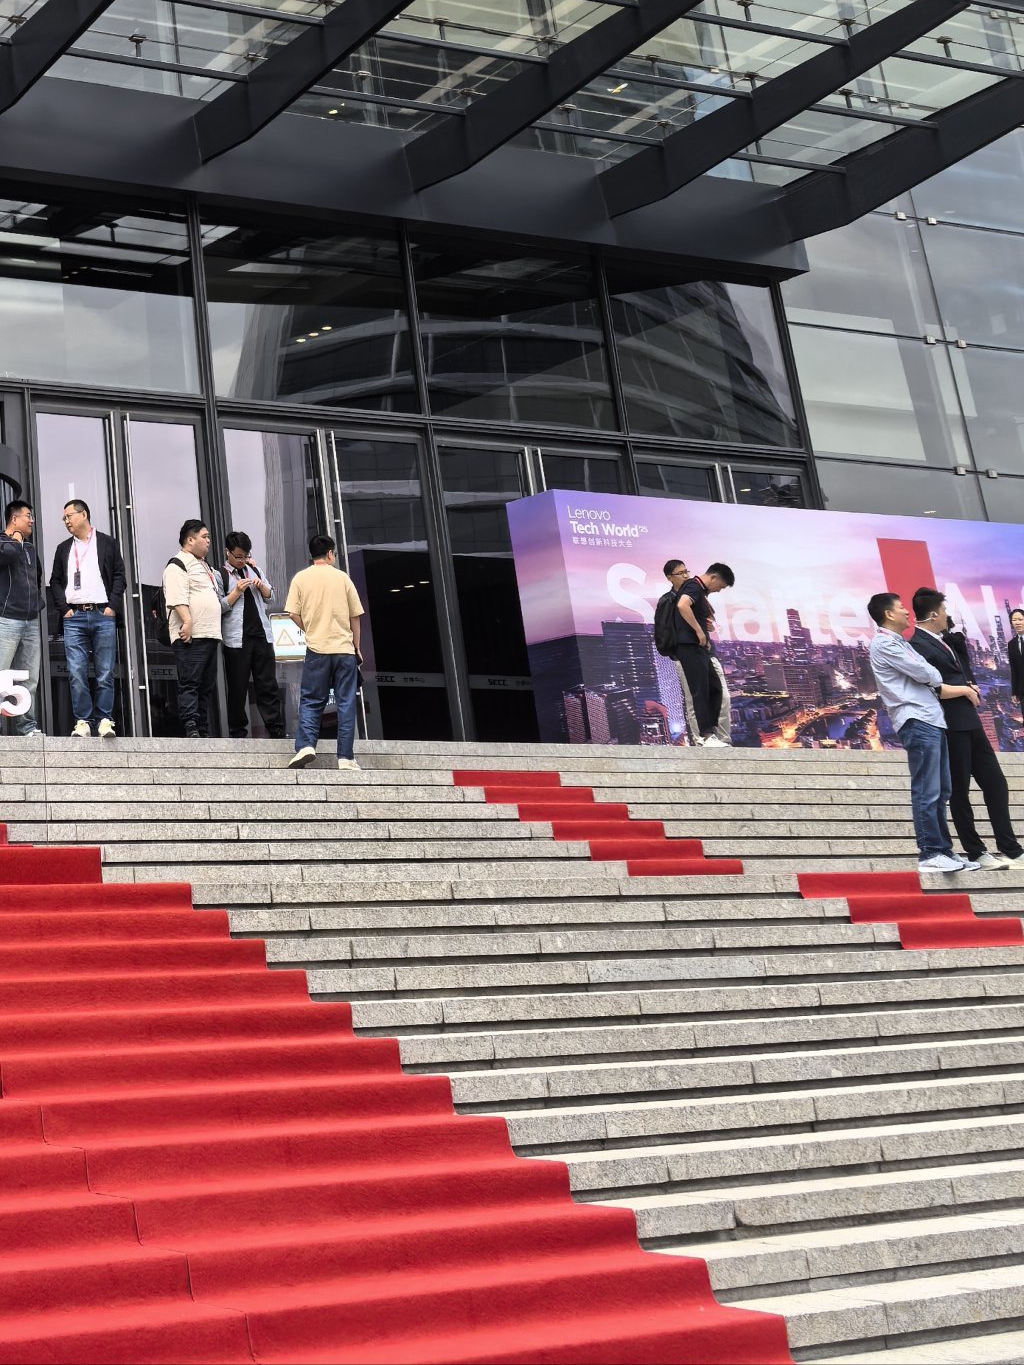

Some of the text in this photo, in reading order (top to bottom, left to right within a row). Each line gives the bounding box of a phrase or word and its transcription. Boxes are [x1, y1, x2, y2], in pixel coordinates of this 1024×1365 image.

[567, 505, 611, 521] Lenovo
[569, 520, 599, 535] Tech
[601, 523, 640, 538] World
[572, 536, 633, 548] 联想创新科技大会
